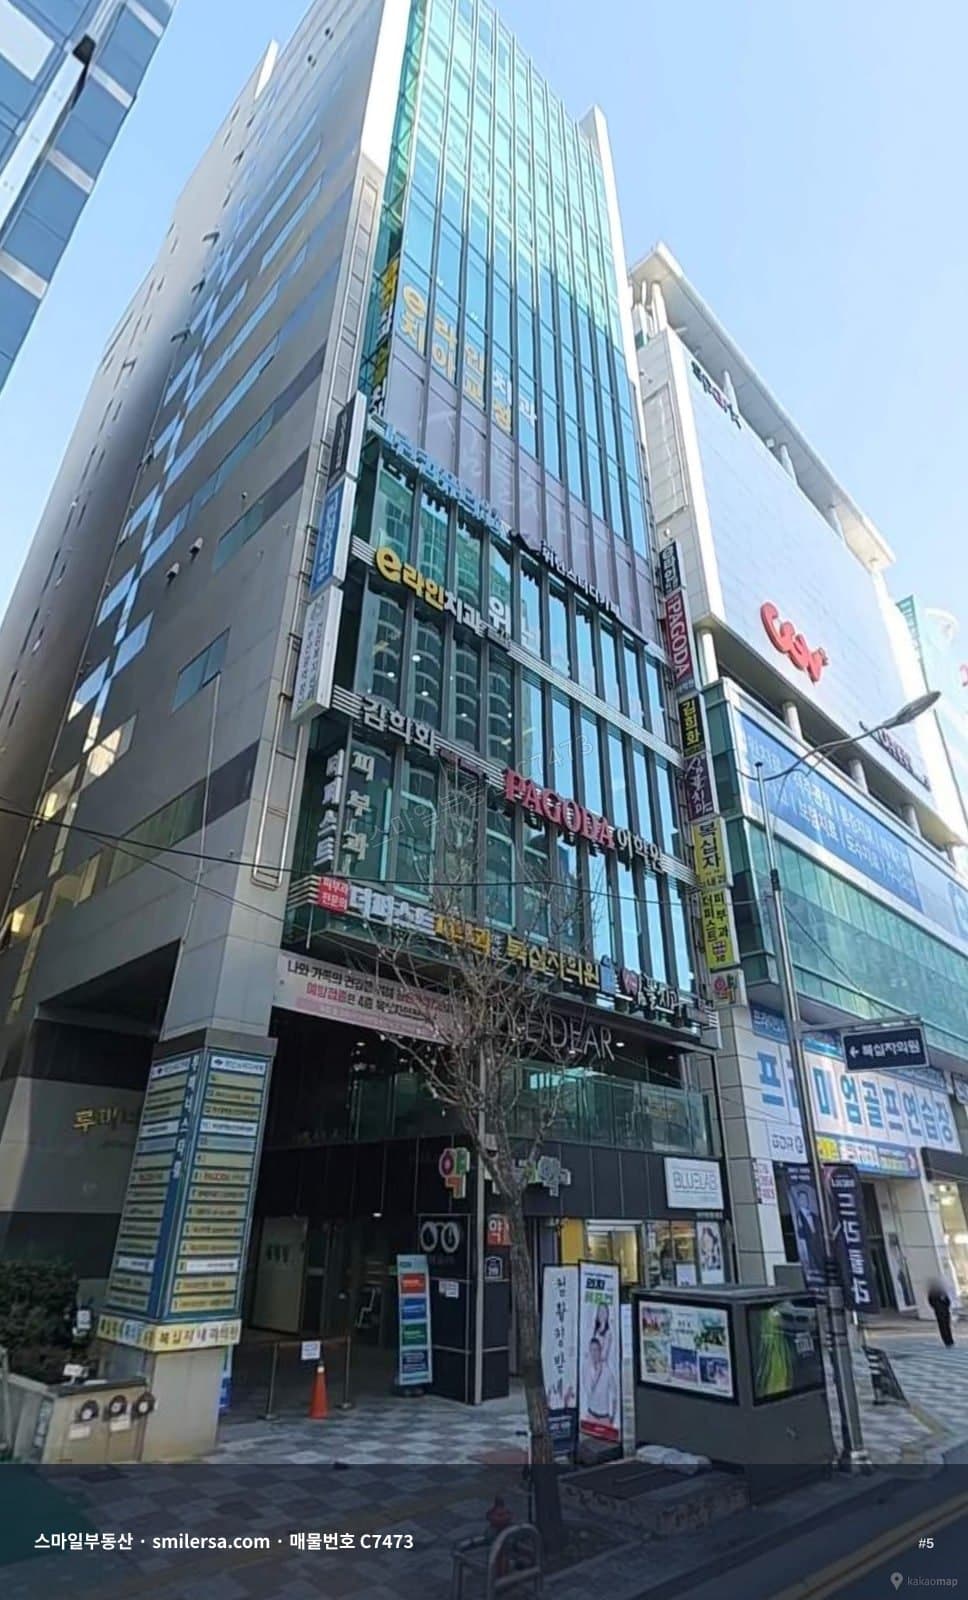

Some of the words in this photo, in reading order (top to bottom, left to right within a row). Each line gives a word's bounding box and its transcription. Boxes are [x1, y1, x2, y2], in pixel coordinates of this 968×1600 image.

[669, 600, 691, 679] PAGODA
[504, 767, 615, 852] PAGODA
[287, 959, 310, 977] 나와
[311, 967, 343, 985] 가족의
